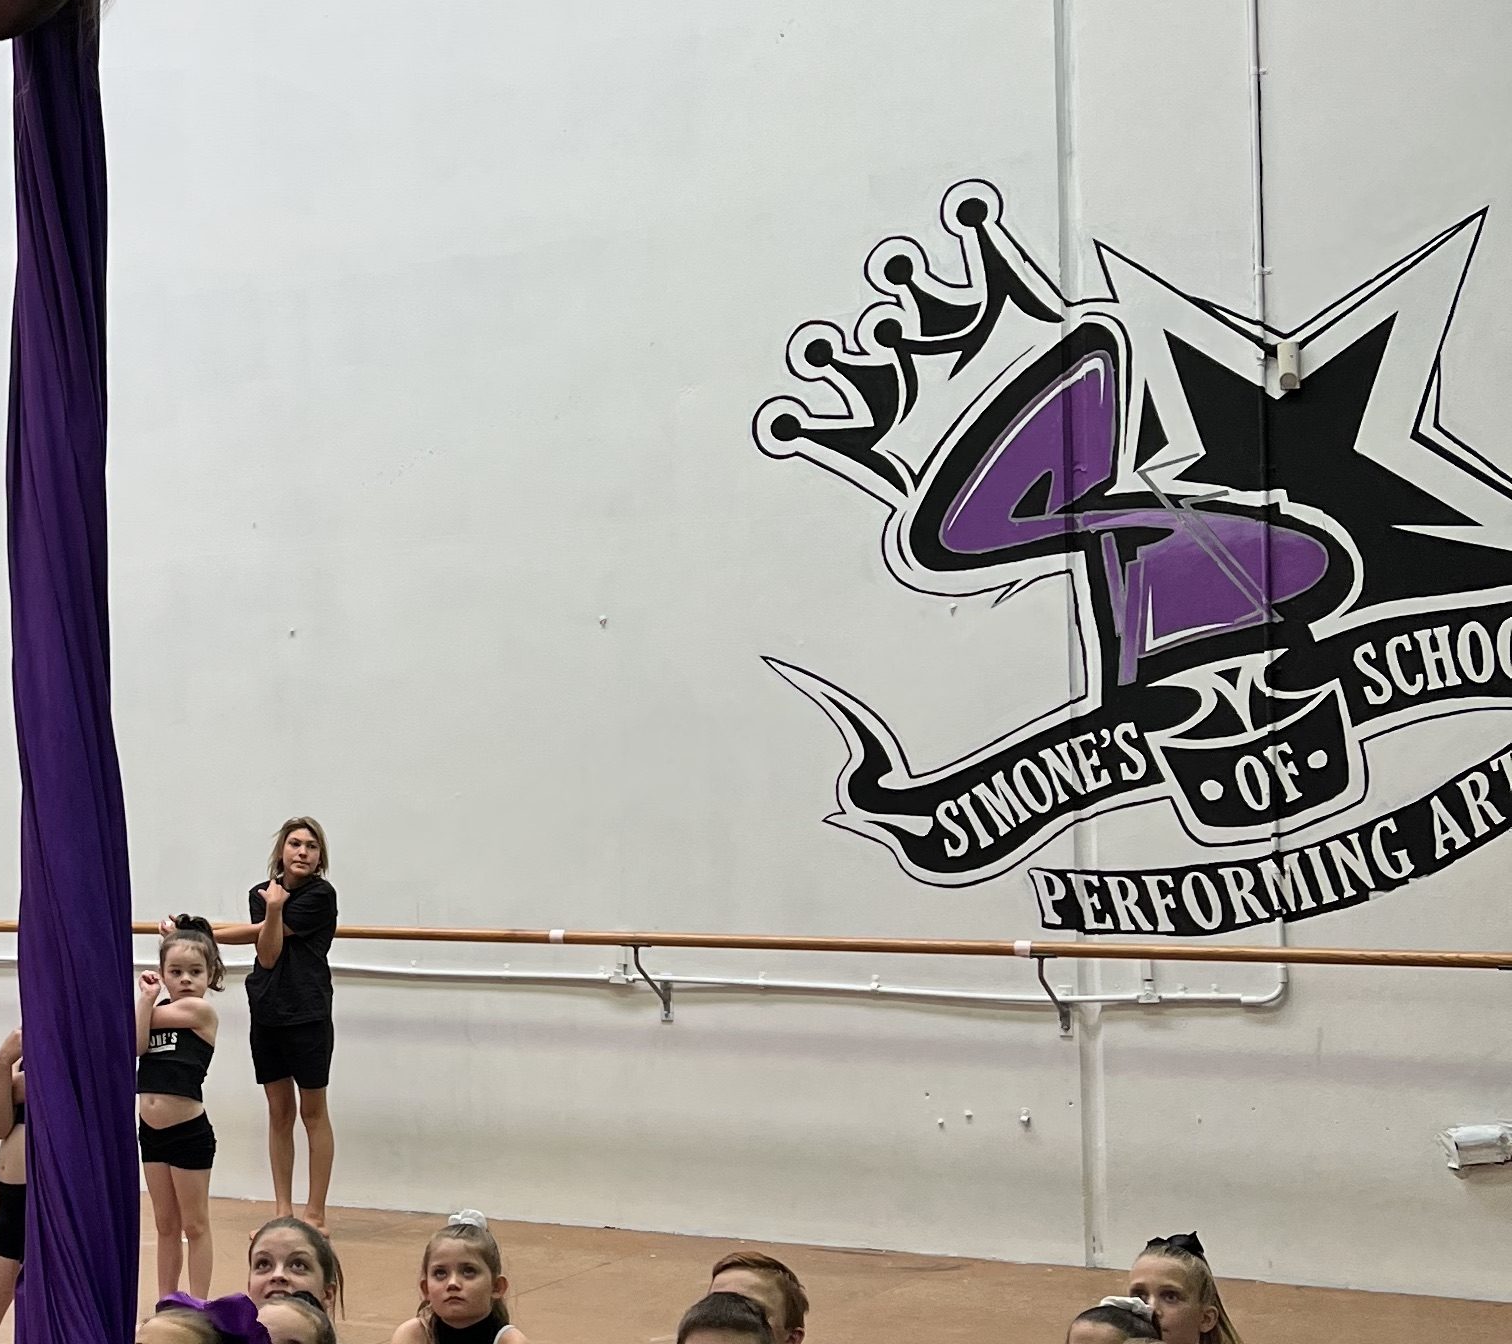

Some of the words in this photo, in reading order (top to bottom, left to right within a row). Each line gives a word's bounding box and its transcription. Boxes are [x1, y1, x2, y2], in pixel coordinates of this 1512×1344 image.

[935, 721, 1147, 858] SIMONE'S
[1234, 742, 1303, 811] OF
[1029, 817, 1415, 932] PERFORMING
